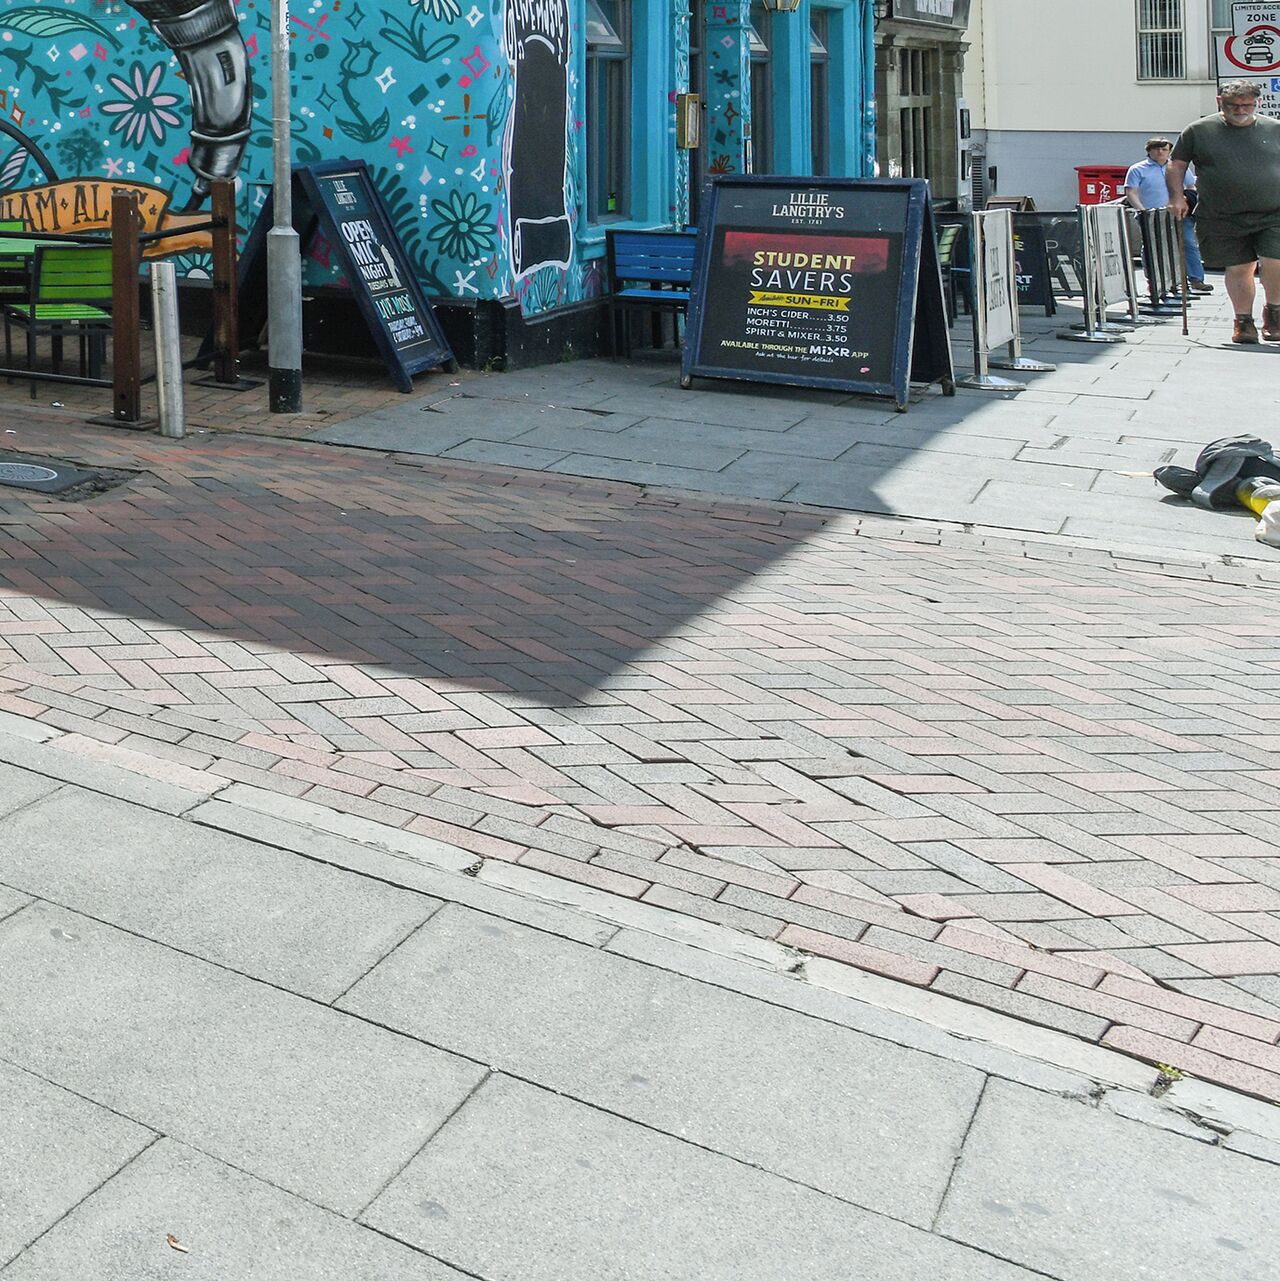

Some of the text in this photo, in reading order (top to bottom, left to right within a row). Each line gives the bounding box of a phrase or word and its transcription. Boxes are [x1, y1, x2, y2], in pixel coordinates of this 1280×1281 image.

[1247, 13, 1277, 22] ZONE
[790, 193, 828, 205] LILLIE
[772, 205, 844, 219] LANGTRY'S
[340, 219, 374, 243] OPEN
[349, 239, 380, 266] MIC
[753, 251, 855, 270] STUDENT
[359, 263, 388, 281] NIGHT
[750, 268, 852, 293] SAVERS
[747, 307, 778, 317] INCH'S
[827, 314, 849, 323] 3.50
[745, 327, 775, 337] SPIRIT
[825, 334, 848, 343] 3.50
[826, 324, 847, 333] 3.75
[721, 339, 759, 350] AVAILABLE
[761, 342, 794, 352] THROUGH
[795, 346, 808, 354] THE
[852, 351, 870, 359] APP
